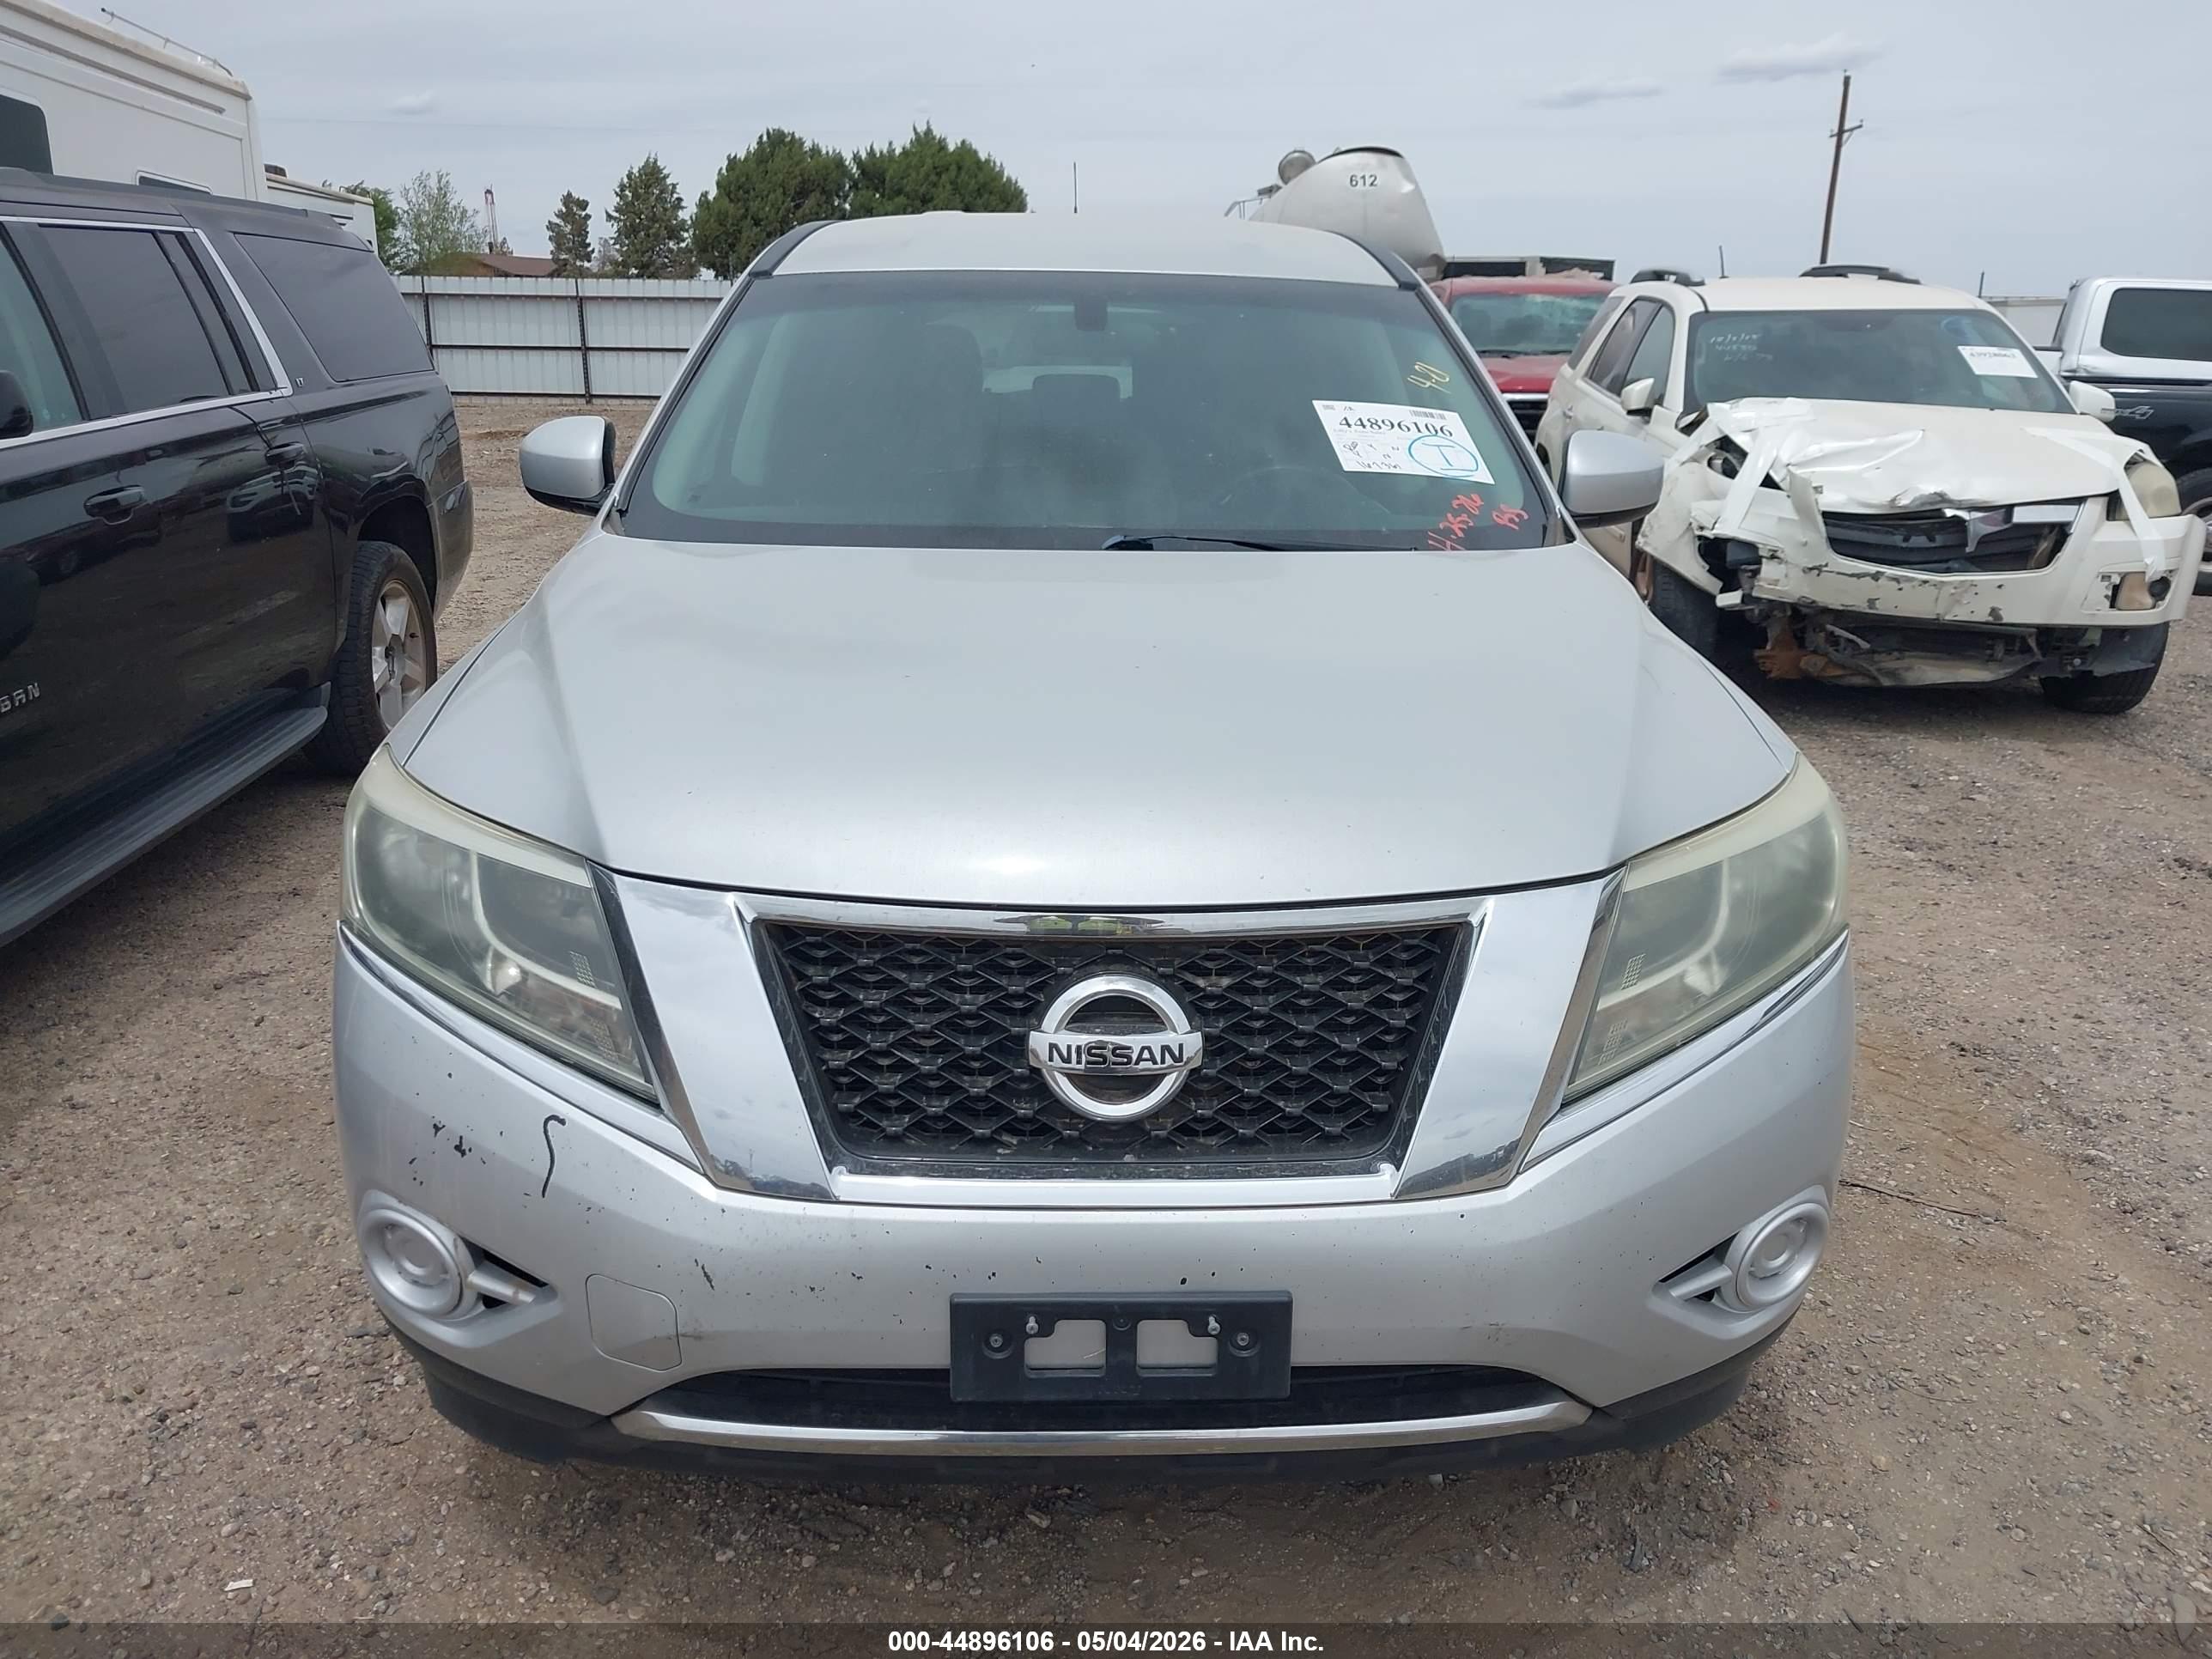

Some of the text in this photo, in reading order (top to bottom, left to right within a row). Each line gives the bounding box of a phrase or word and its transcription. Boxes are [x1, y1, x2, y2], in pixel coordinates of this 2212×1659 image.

[1349, 173, 1378, 187] 612
[1339, 415, 1454, 438] 44896106
[0, 683, 40, 713] BAN
[1048, 1042, 1184, 1066] NISSAN
